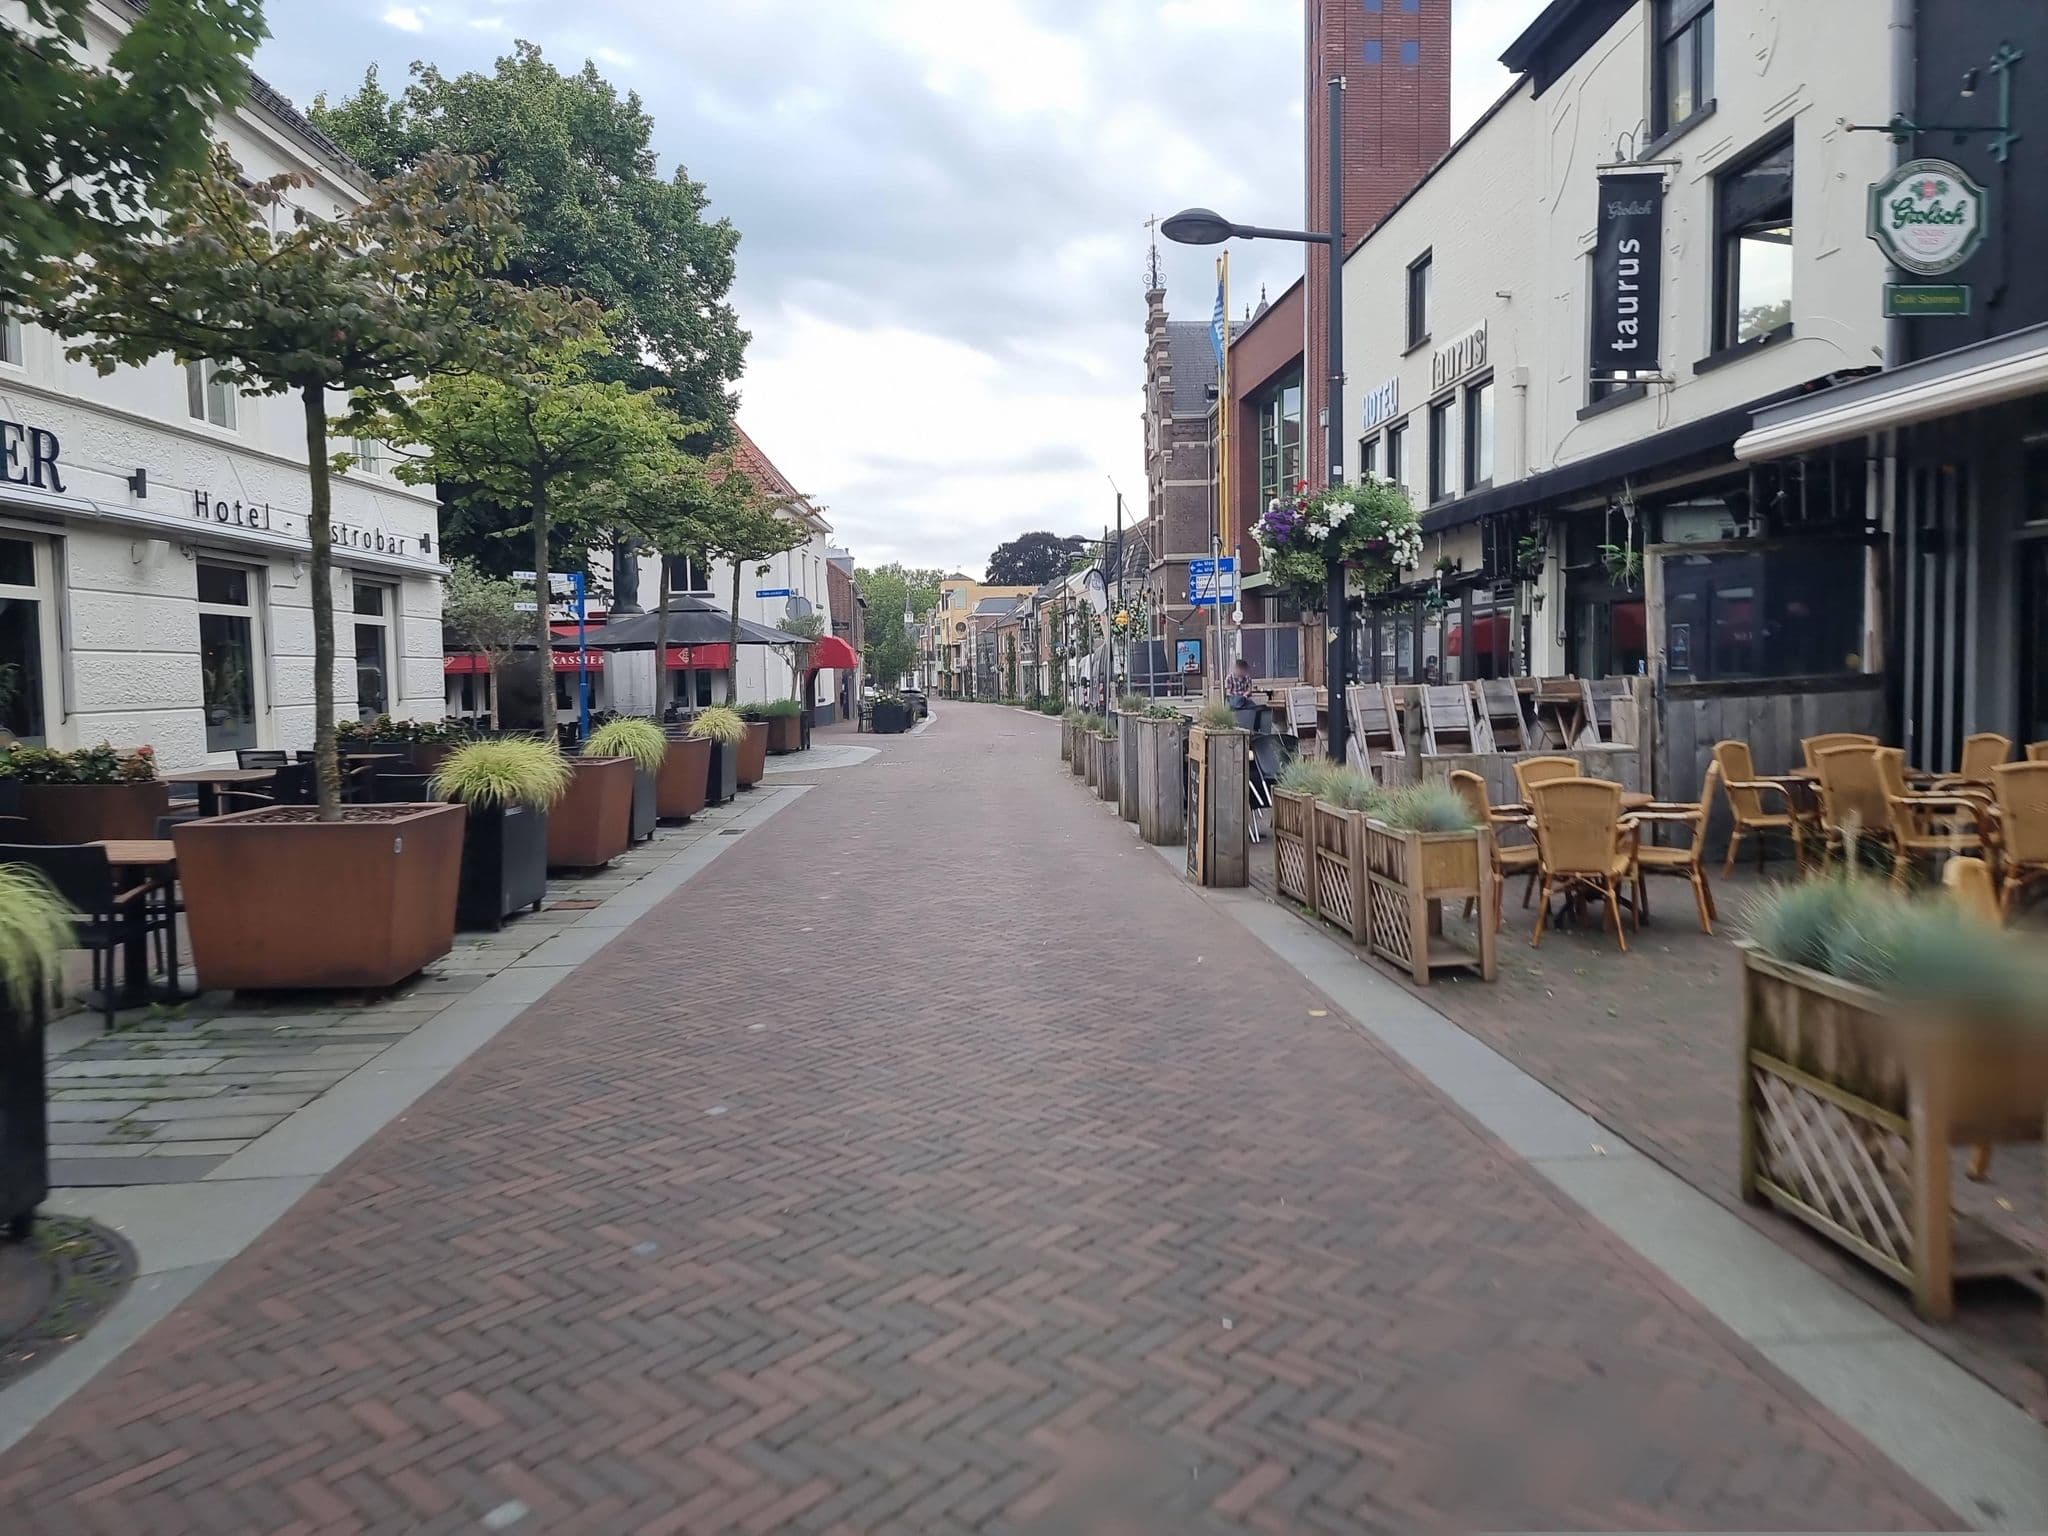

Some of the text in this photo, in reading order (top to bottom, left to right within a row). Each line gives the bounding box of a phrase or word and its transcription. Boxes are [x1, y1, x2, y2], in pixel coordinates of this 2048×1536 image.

[1607, 200, 1653, 220] Grolsch
[1891, 196, 1967, 230] Grolsch
[1610, 238, 1641, 352] taurus
[1361, 378, 1399, 430] HOTEL
[0, 420, 67, 493] ER
[194, 489, 270, 530] Hotel
[307, 514, 405, 554] strobar
